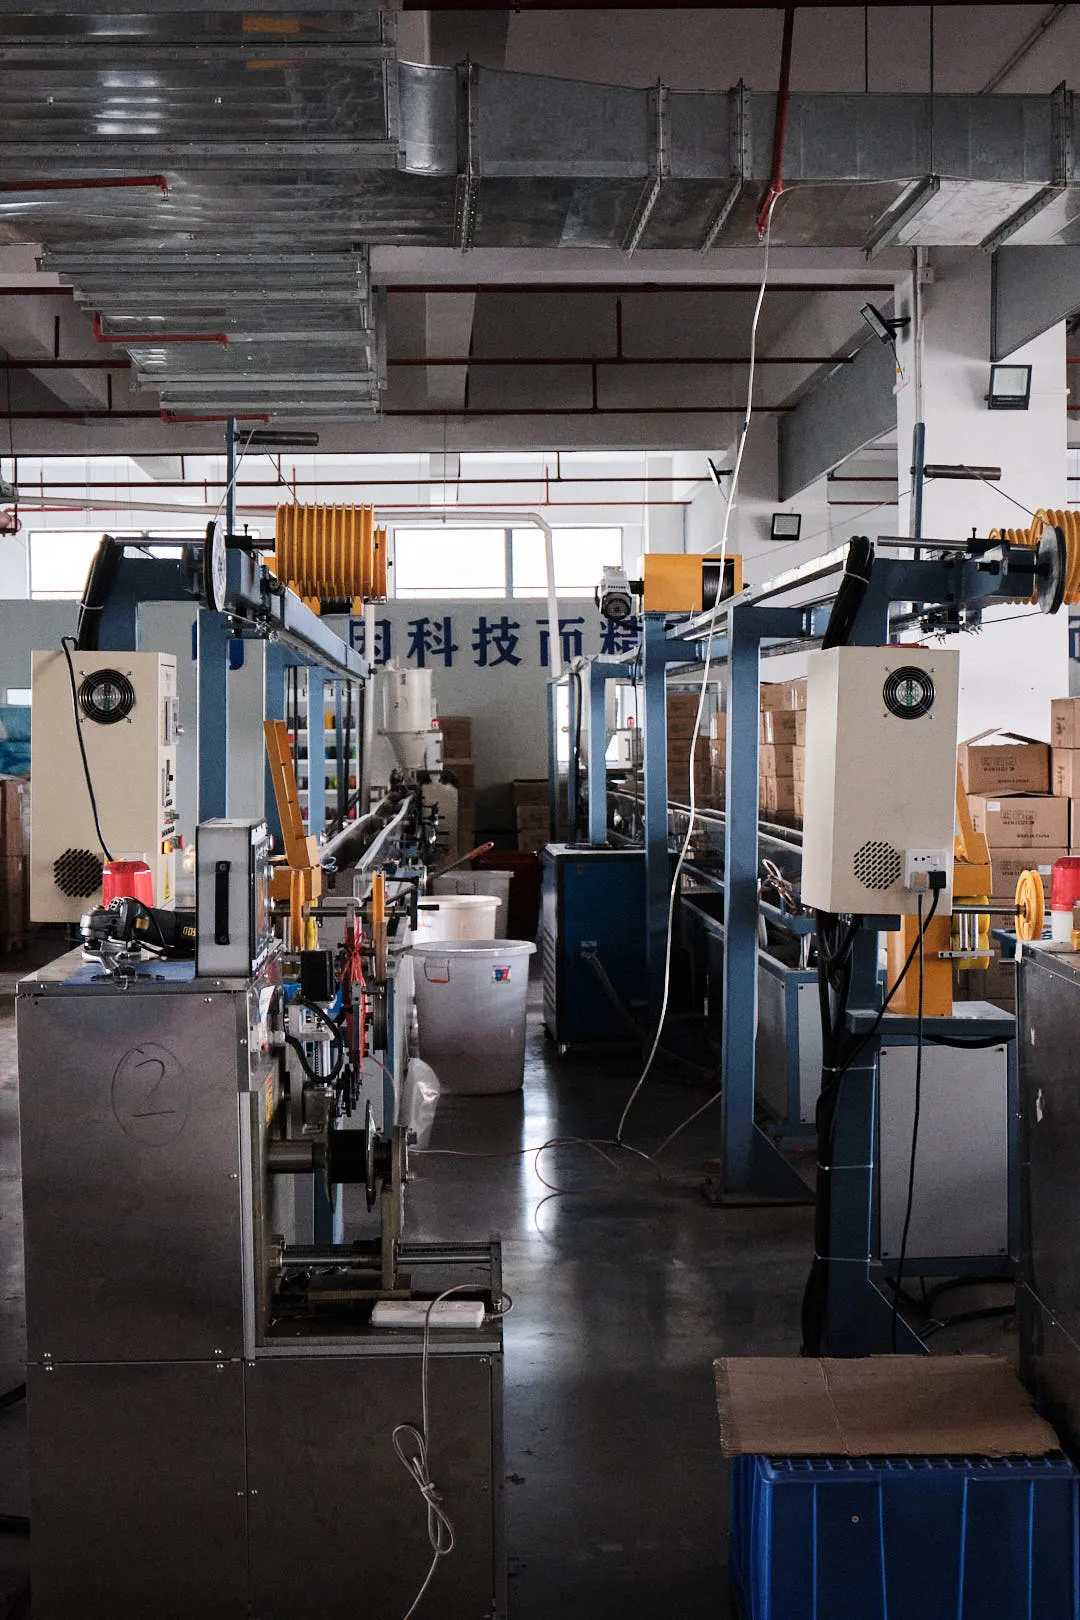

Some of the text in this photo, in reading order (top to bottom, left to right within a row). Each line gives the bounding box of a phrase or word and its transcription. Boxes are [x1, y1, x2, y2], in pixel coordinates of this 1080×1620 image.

[349, 615, 697, 667] 因科技而精
